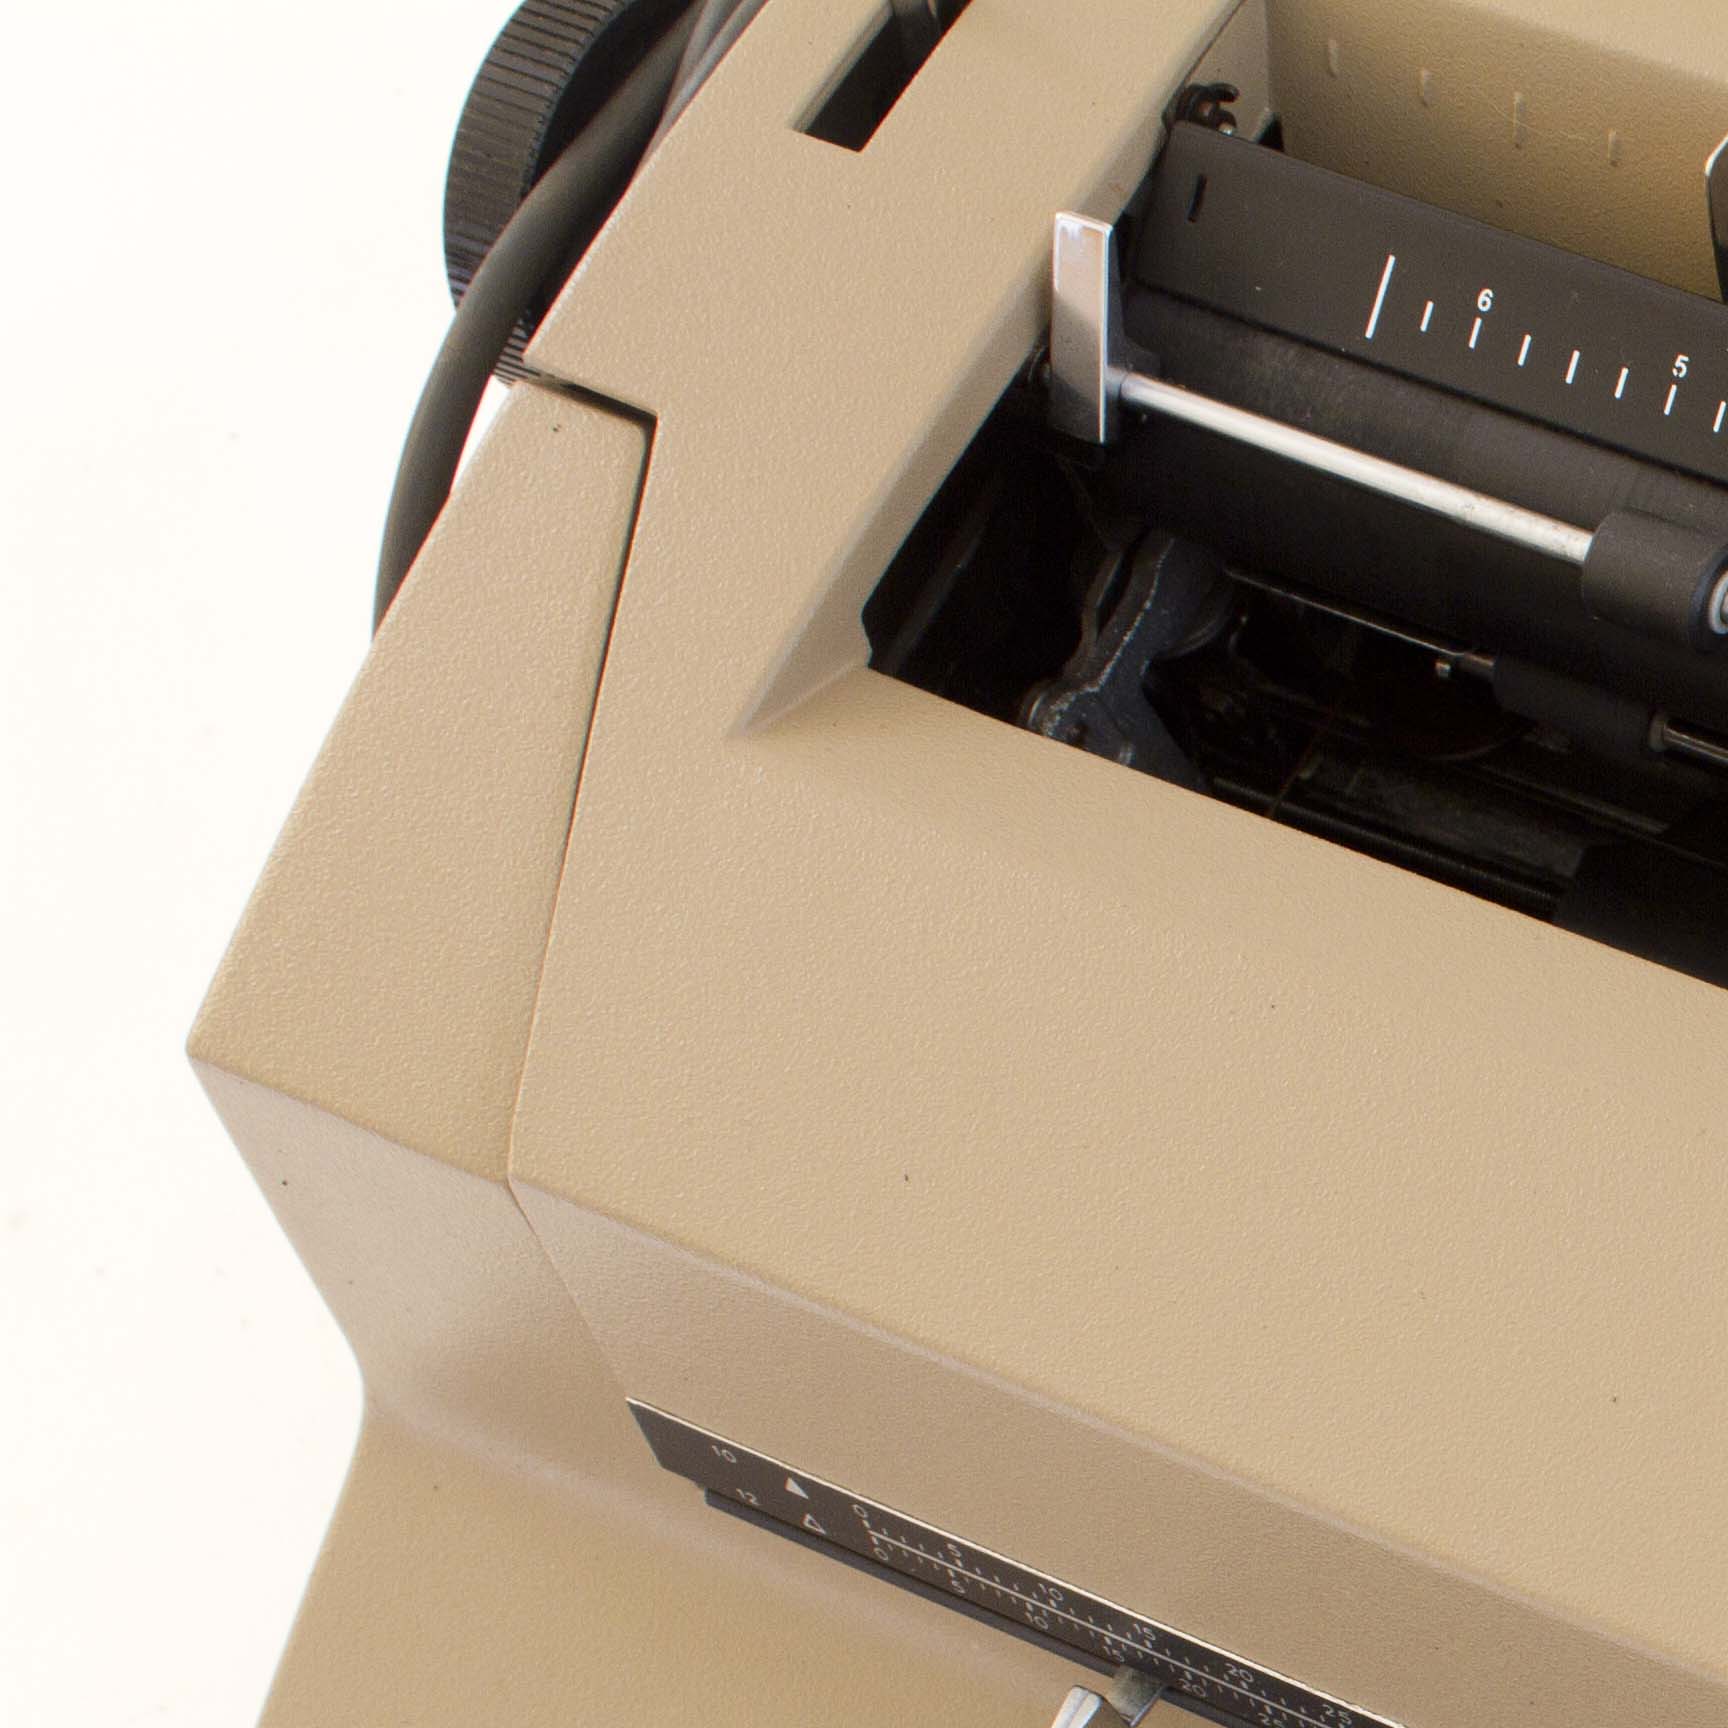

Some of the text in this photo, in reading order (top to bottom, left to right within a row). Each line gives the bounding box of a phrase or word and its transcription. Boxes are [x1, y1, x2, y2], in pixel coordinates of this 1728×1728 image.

[1477, 288, 1494, 312] 6
[1672, 354, 1689, 378] 5
[712, 1445, 737, 1463] 10
[853, 1504, 867, 1518] 0
[946, 1544, 962, 1558] 5
[1038, 1584, 1064, 1602] 10
[1133, 1624, 1157, 1642] 15
[1225, 1664, 1255, 1684] 20
[1323, 1704, 1352, 1725] 25
[736, 1488, 760, 1506] 12
[874, 1548, 888, 1561] 0
[951, 1580, 966, 1597] 5
[1025, 1613, 1049, 1631] 10
[1178, 1678, 1208, 1698] 20
